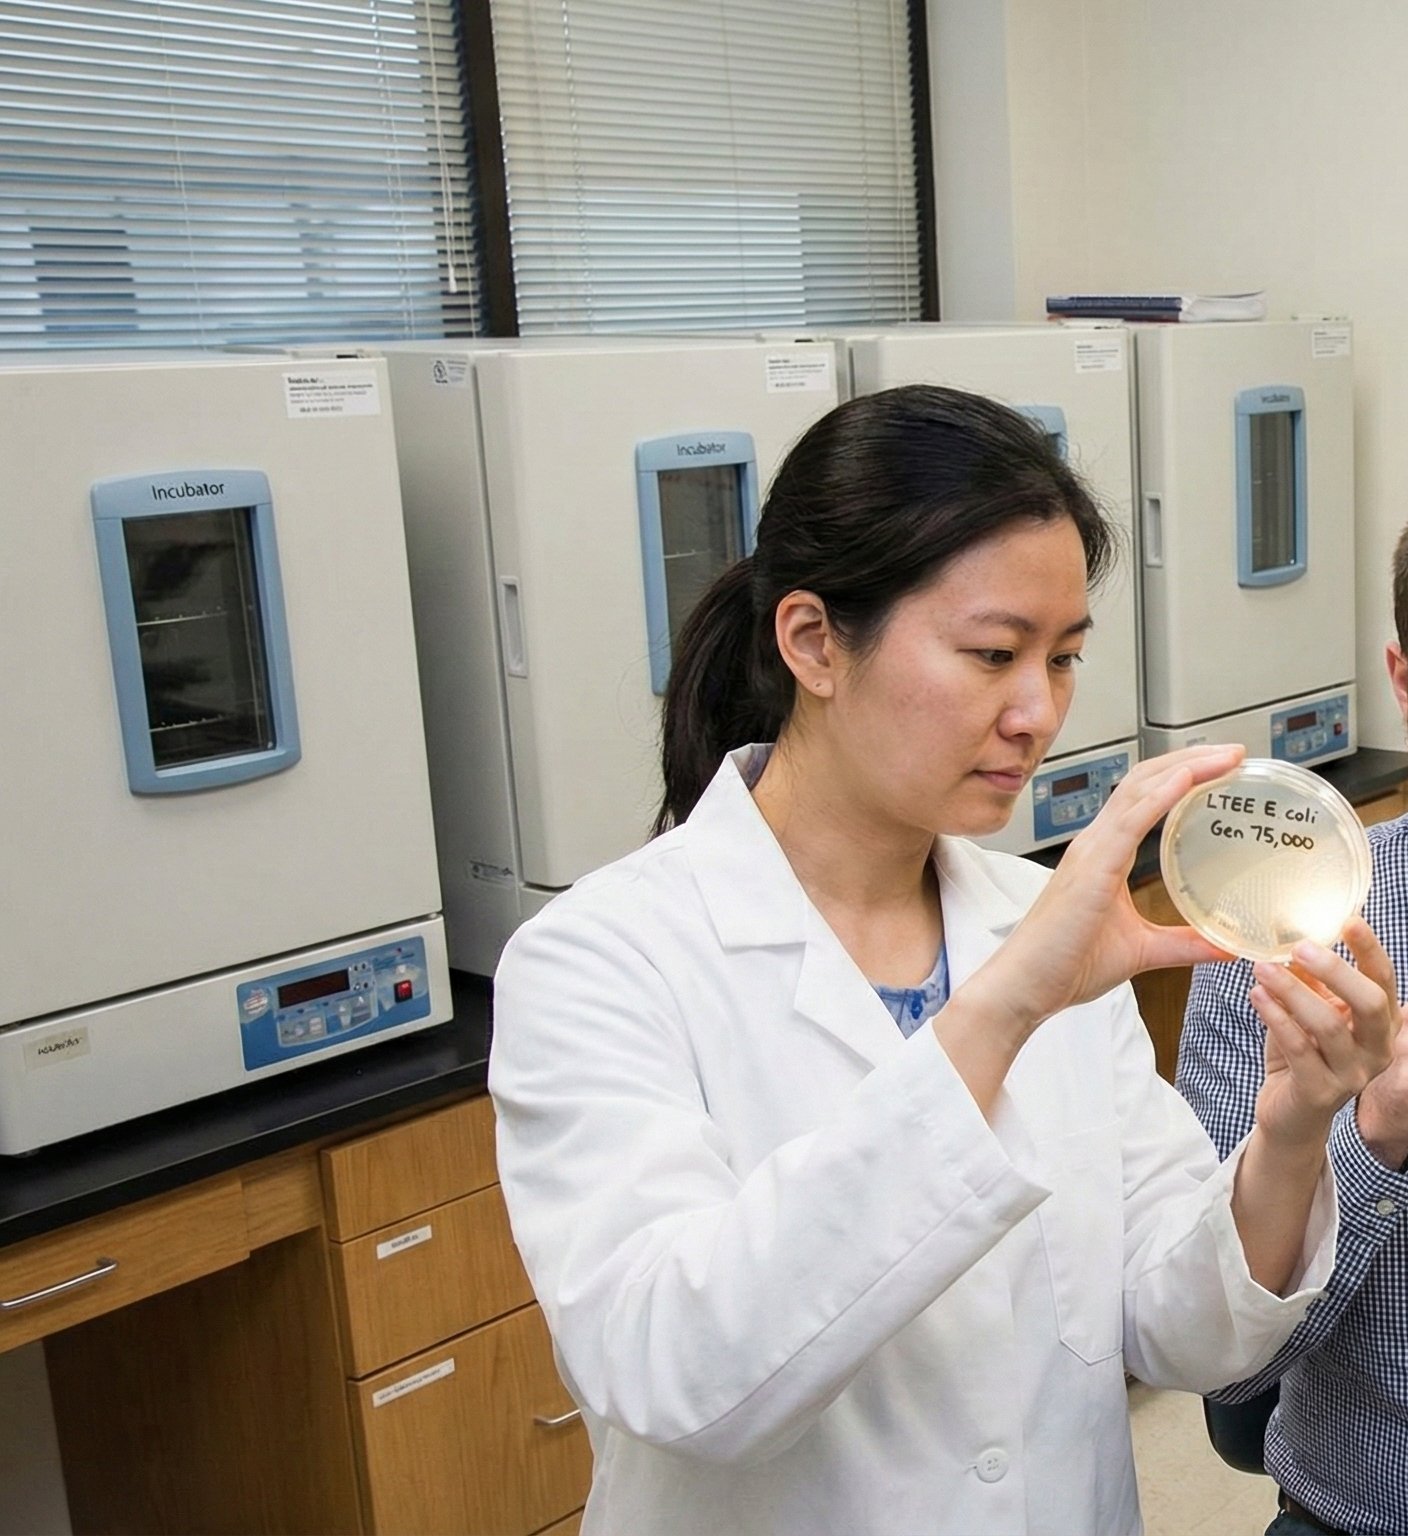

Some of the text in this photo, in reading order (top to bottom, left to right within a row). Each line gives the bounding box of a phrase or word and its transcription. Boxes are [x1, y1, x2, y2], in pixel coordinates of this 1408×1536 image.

[1206, 793, 1319, 824] LTEE E coli
[1210, 819, 1315, 850] Gen 75,000
